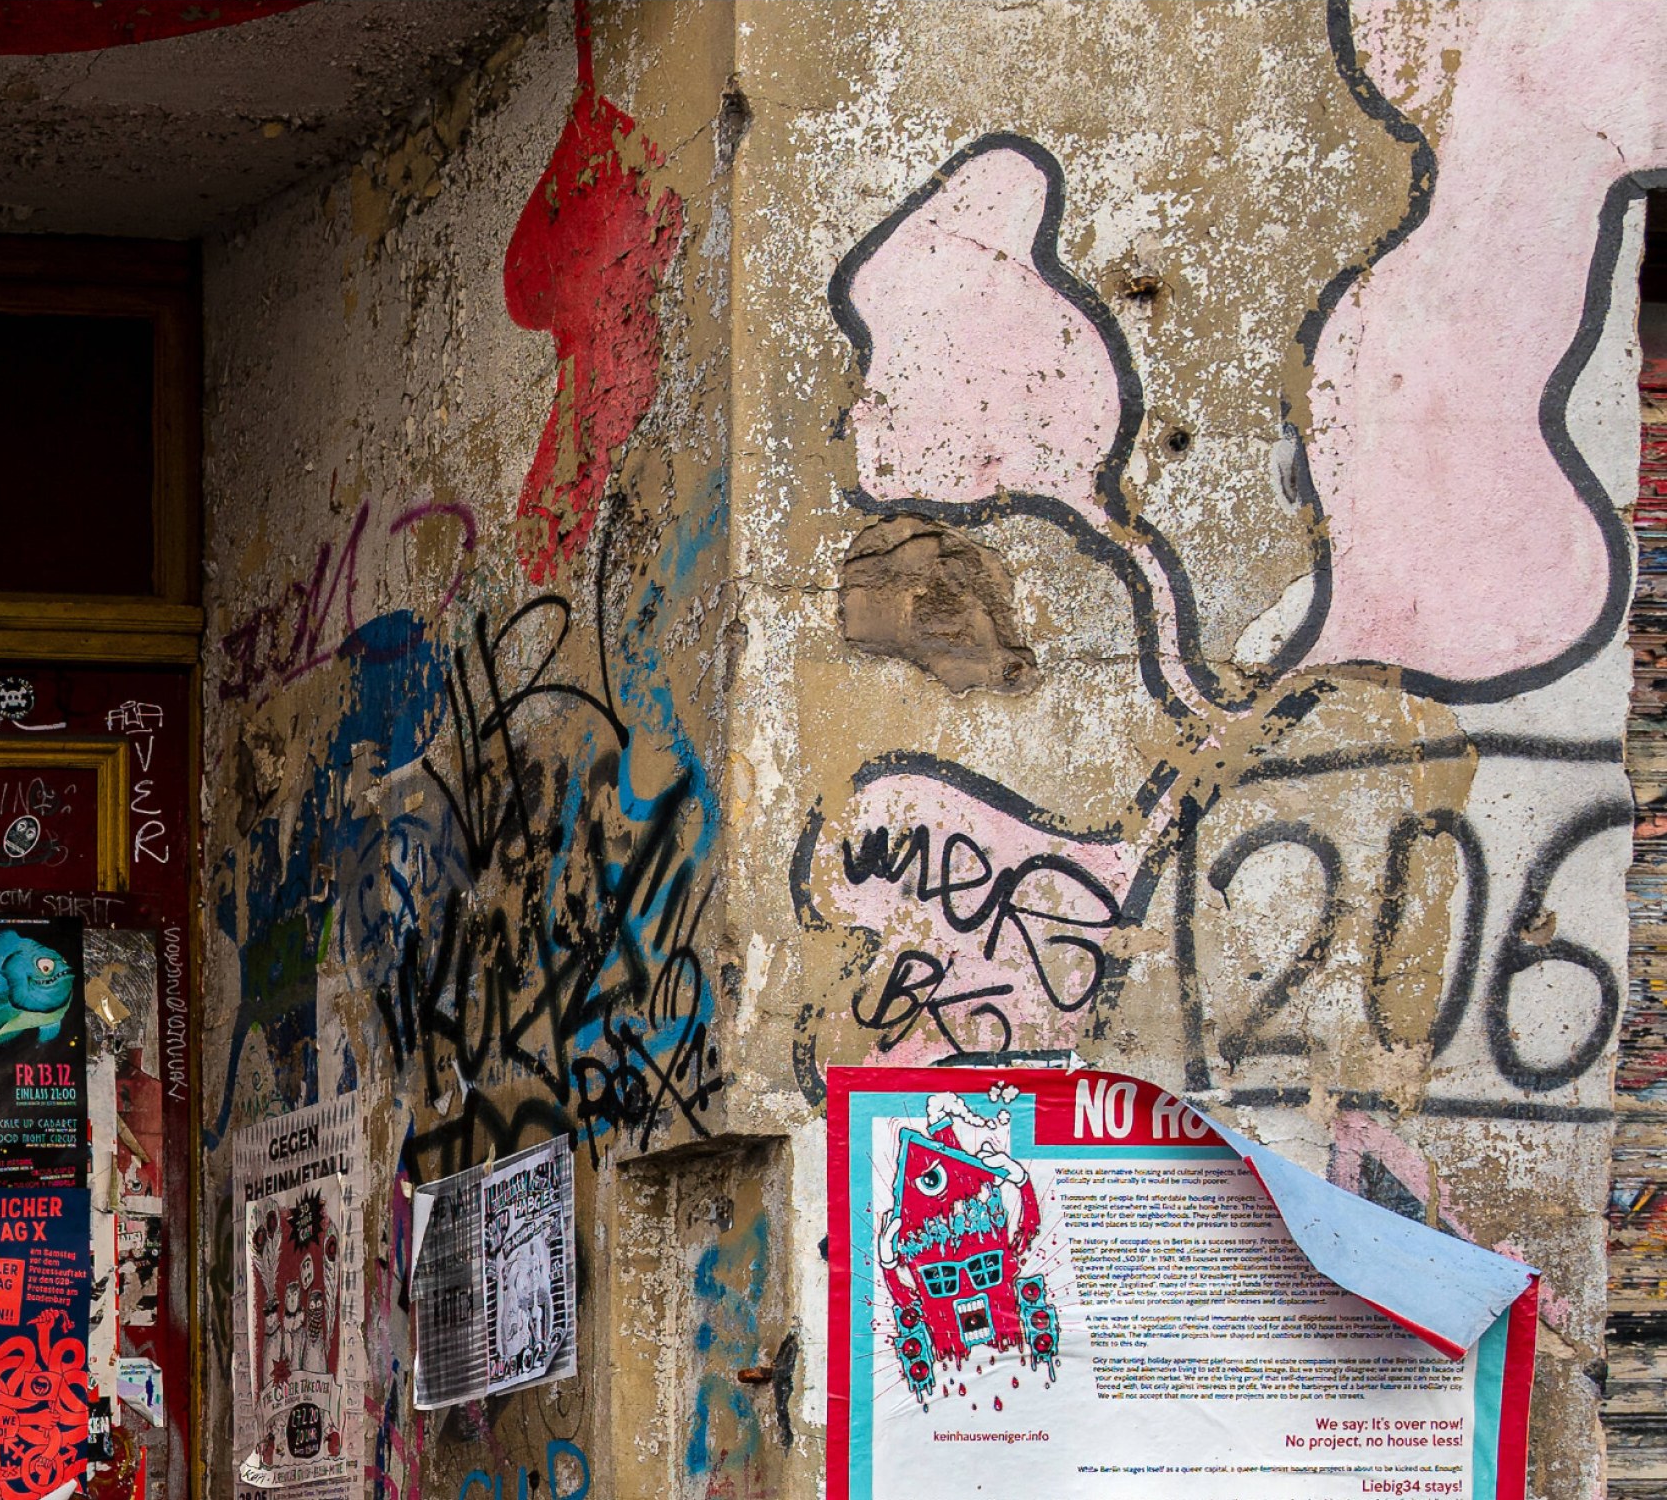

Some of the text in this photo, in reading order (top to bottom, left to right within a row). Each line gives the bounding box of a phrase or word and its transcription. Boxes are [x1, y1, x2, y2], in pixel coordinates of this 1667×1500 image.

[1209, 800, 1632, 1092] 206
[15, 1063, 76, 1086] FR 13.12.
[15, 1088, 76, 1101] EINLASS 21:00
[1073, 1078, 1138, 1140] NO
[49, 1133, 77, 1144] CIRCUS
[269, 1124, 319, 1162] GEGEN
[33, 1221, 47, 1242] X
[1, 1414, 16, 1426] WE
[1315, 1417, 1464, 1433] We say: It's over now!
[933, 1429, 1050, 1444] keinhausweniger.info
[1286, 1434, 1463, 1451] No project, no house less!
[1362, 1479, 1462, 1496] Liebig34 stays!
